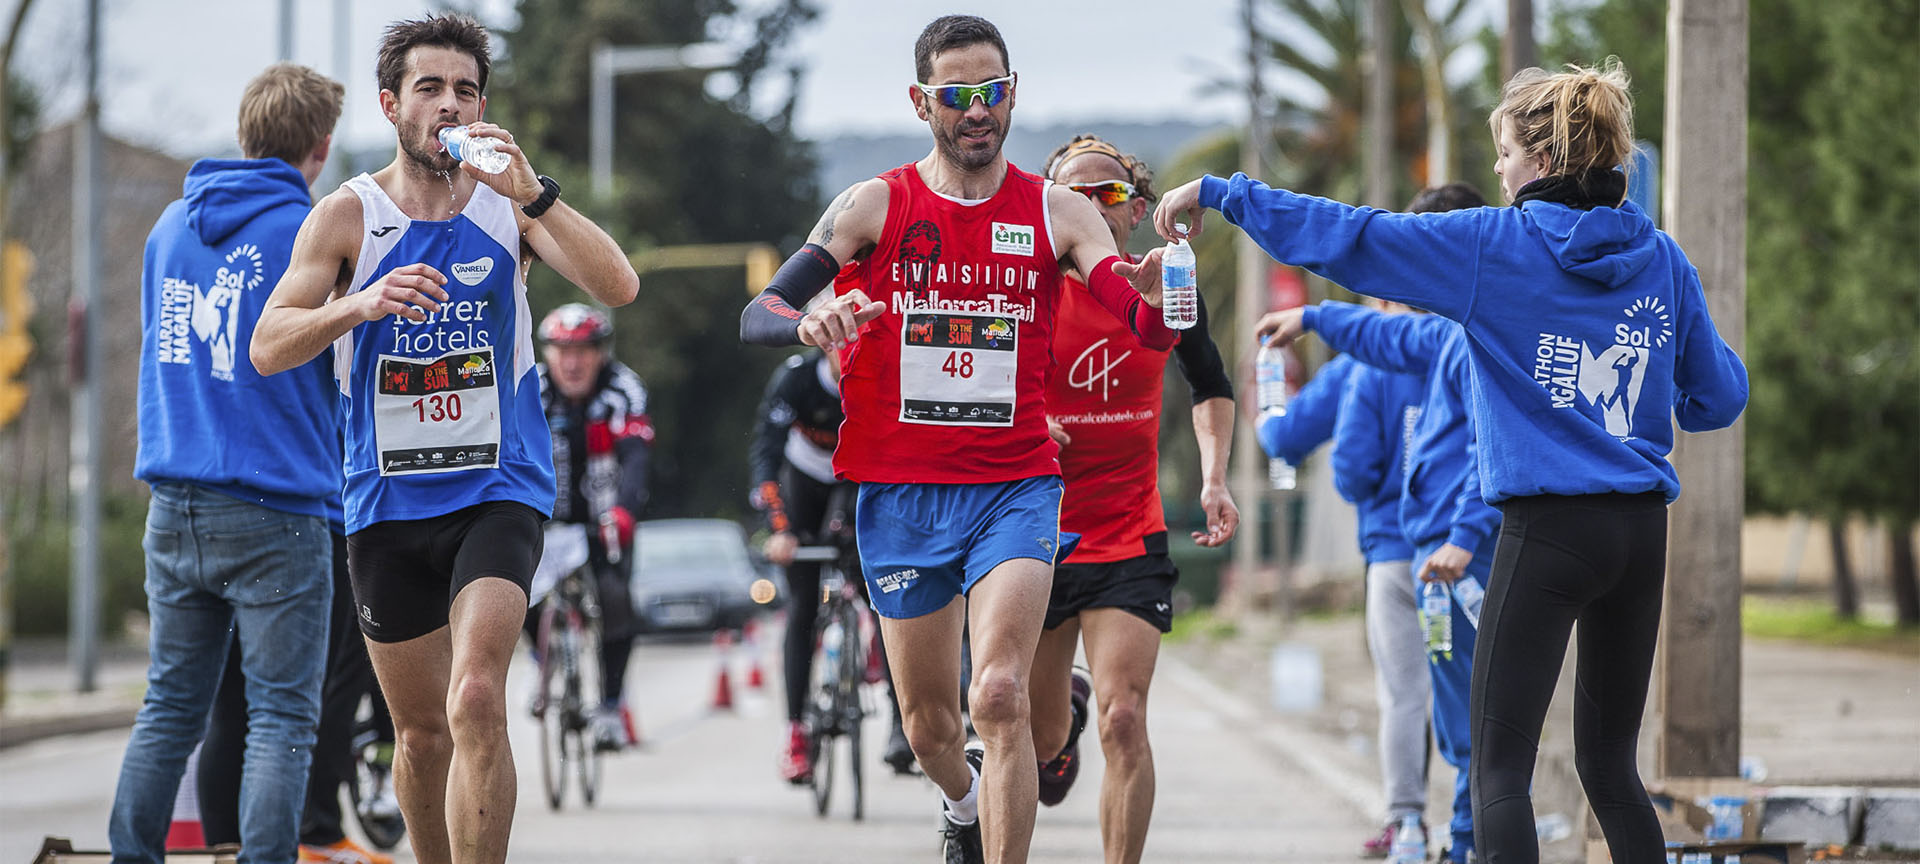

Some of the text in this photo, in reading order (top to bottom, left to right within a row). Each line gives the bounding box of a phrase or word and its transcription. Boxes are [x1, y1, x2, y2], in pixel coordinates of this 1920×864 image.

[216, 267, 245, 289] Sol
[454, 265, 488, 274] VANRELL
[159, 277, 176, 363] MARATHON
[173, 279, 194, 364] MAGALUF
[949, 324, 972, 333] TO THE
[392, 324, 489, 353] hotels
[948, 332, 972, 344] SUN
[1615, 323, 1651, 347] Sol
[942, 350, 974, 379] 48
[424, 374, 449, 390] SUN
[412, 393, 462, 422] 130
